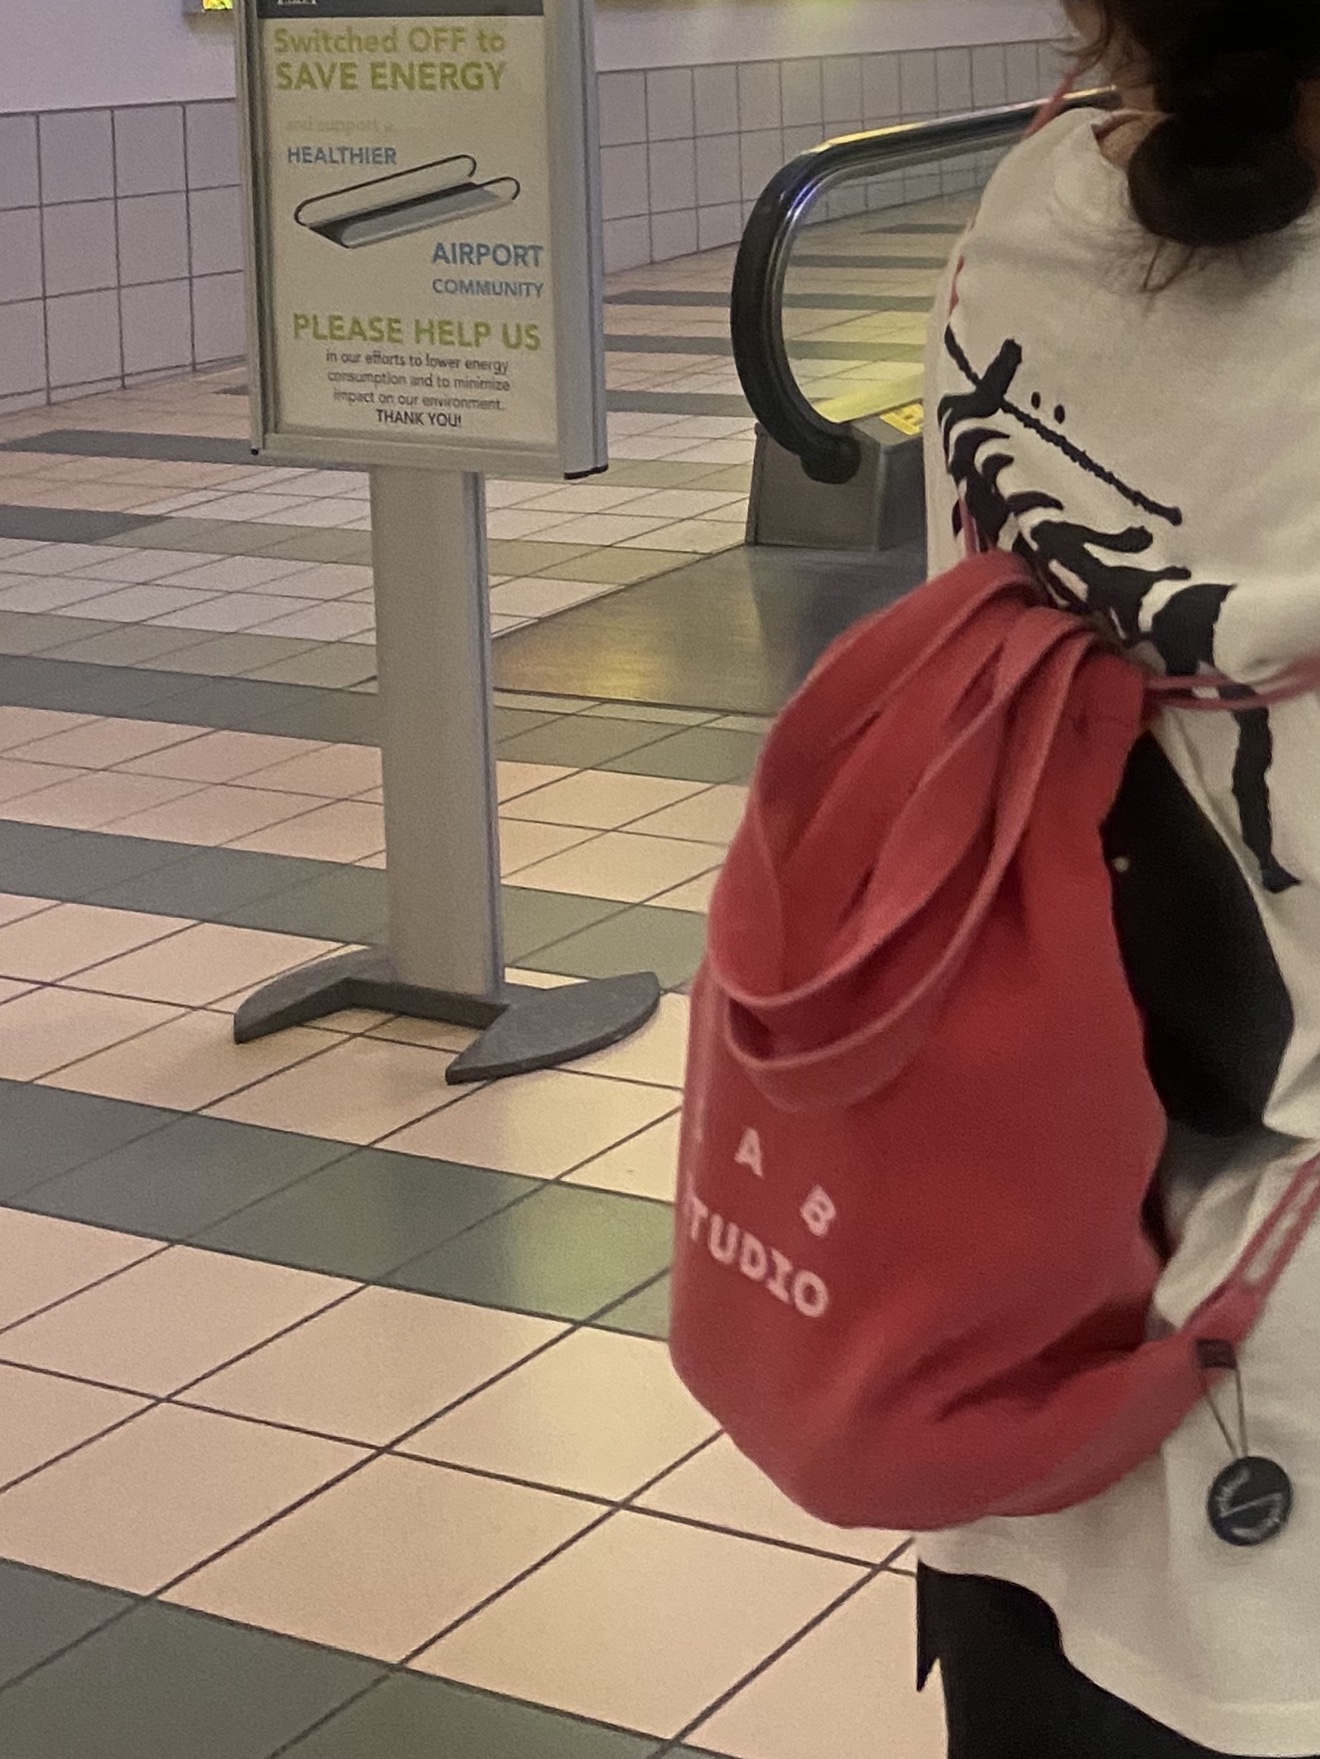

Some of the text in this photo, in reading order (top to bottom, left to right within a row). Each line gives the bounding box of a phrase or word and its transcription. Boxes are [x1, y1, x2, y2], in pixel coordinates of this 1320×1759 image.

[273, 25, 506, 54] Switched OFF to
[275, 60, 507, 91] SAVE ENERGY
[286, 144, 397, 166] HEALTHIER
[432, 241, 544, 268] AIRPORT
[432, 278, 545, 299] COMMUNITY
[292, 312, 542, 351] PLEASE HELP US
[326, 349, 510, 376] in our efforts to lower energy
[327, 372, 511, 393] consumption and to minimize
[333, 388, 376, 406] impact
[378, 392, 396, 406] on
[398, 393, 419, 407] our
[375, 409, 463, 429] THANK YOU!
[734, 1126, 765, 1178] A
[685, 1182, 829, 1318] TUDIO
